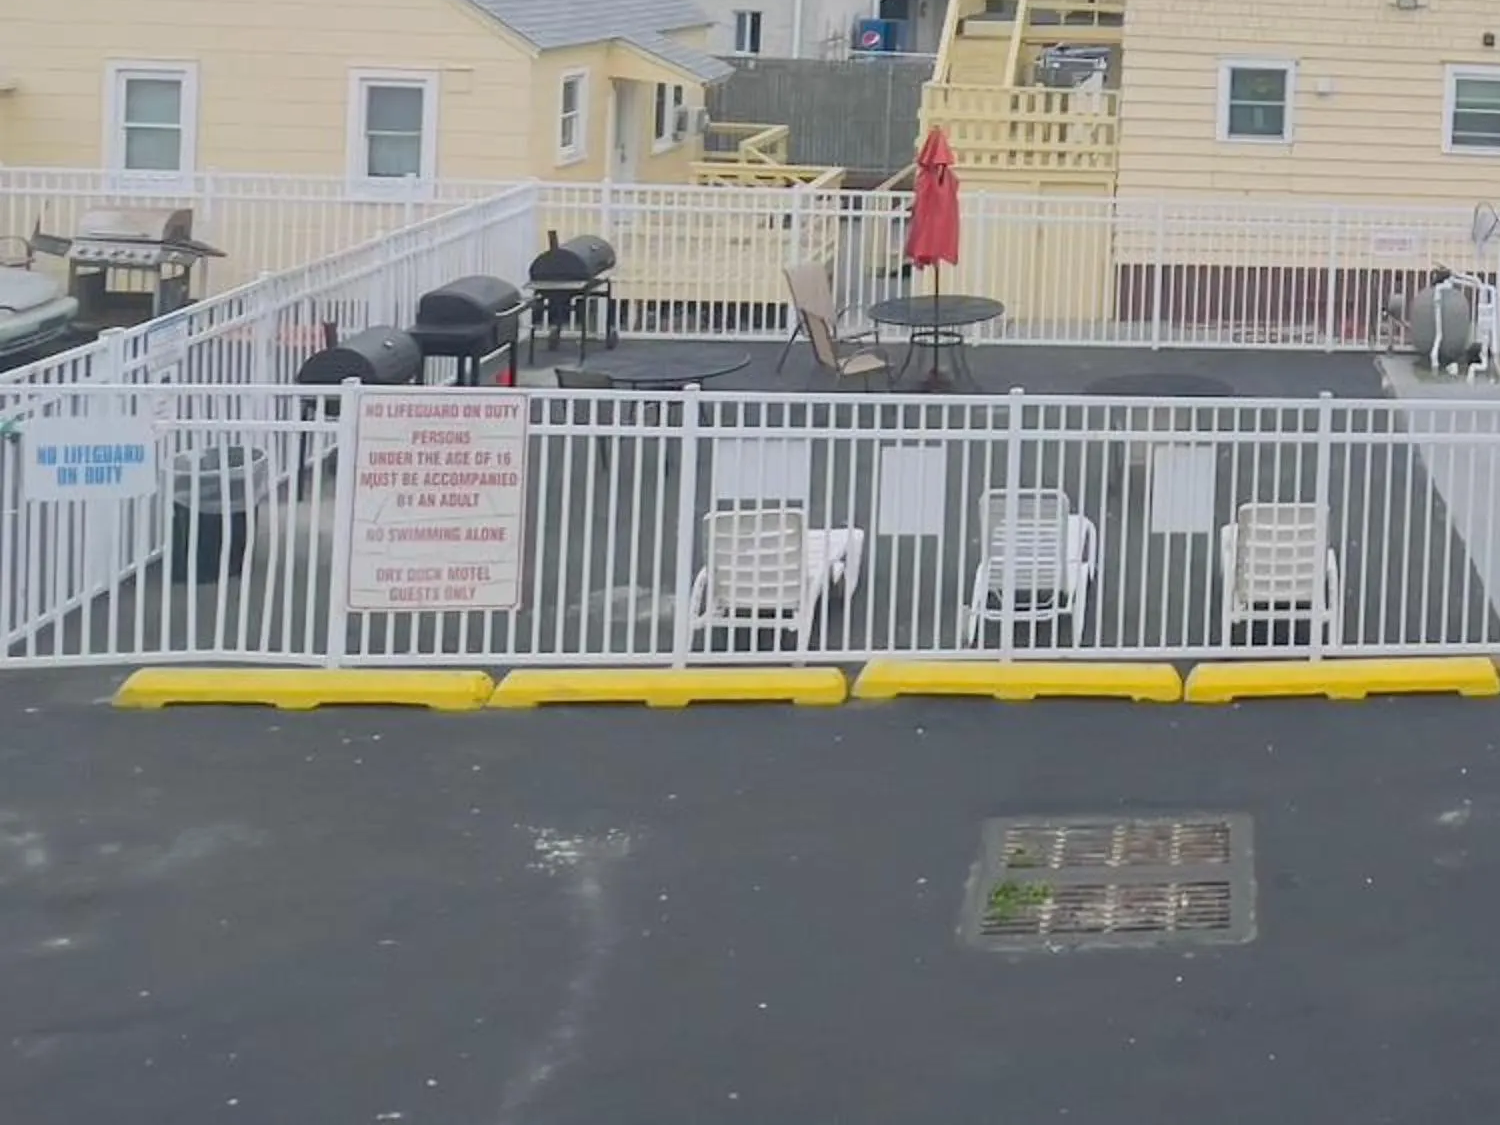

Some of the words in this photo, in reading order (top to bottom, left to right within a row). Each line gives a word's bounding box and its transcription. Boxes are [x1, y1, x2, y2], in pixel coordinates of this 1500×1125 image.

[365, 403, 384, 418] NO
[387, 403, 458, 419] LIFEGUARD
[463, 404, 481, 418] ON
[485, 403, 519, 419] DUTY
[411, 430, 471, 445] PERSONS
[36, 445, 57, 465] NO
[64, 444, 145, 464] LIFEGUARD
[369, 451, 412, 466] UNDER
[417, 451, 441, 465] THE
[445, 451, 470, 465] AGE
[475, 451, 492, 465] OF
[57, 466, 77, 486] ON
[85, 465, 122, 485] DUTY
[360, 472, 399, 488] MUST
[402, 472, 418, 486] BE
[424, 472, 518, 487] ACCOMPANIED
[418, 493, 435, 507] AN
[440, 493, 480, 507] ADULT
[366, 528, 384, 542] NO
[388, 527, 461, 542] SWIMMING
[464, 527, 507, 542] ALONE
[447, 566, 491, 581] MOTEL
[389, 586, 439, 601] GUESTS
[443, 586, 477, 601] ONLY
